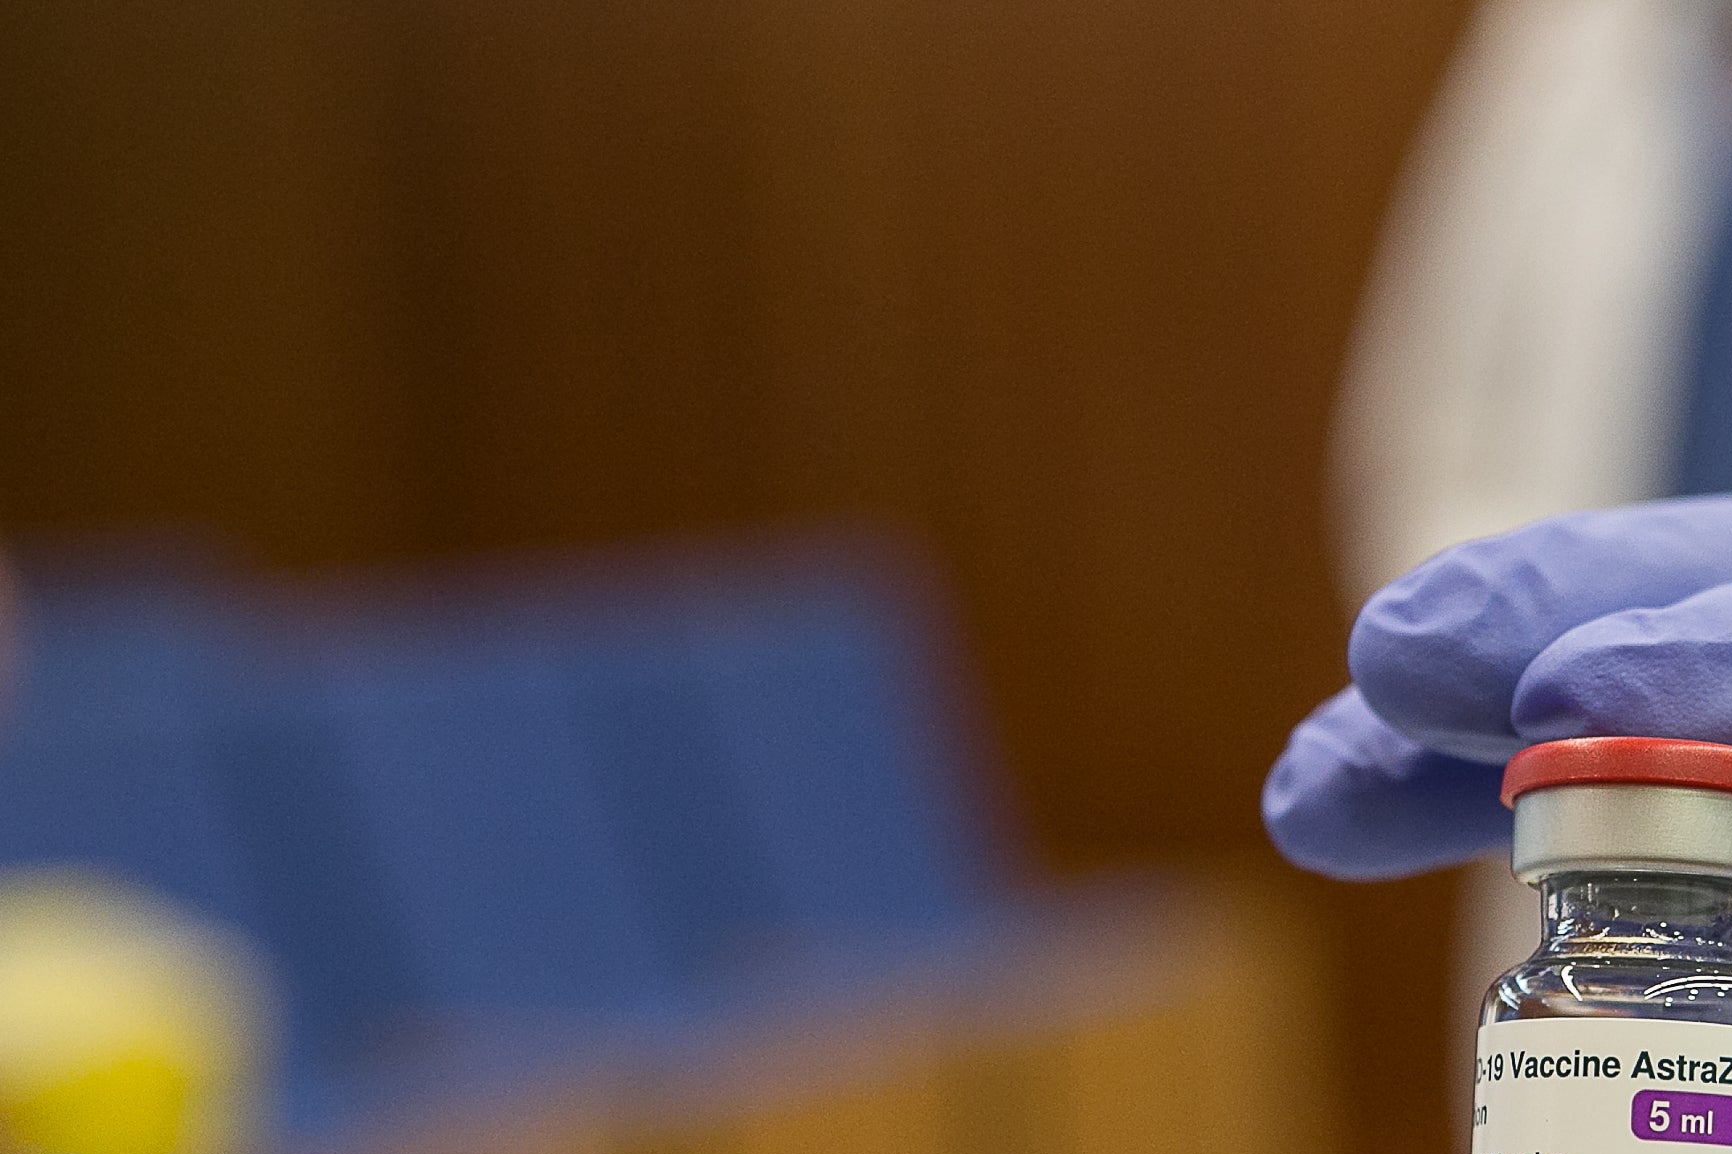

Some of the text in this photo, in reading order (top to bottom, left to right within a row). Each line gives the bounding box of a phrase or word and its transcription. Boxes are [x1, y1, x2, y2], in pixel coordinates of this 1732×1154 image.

[1510, 1049, 1621, 1079] Vaccine
[1649, 1101, 1714, 1135] 5 ml
